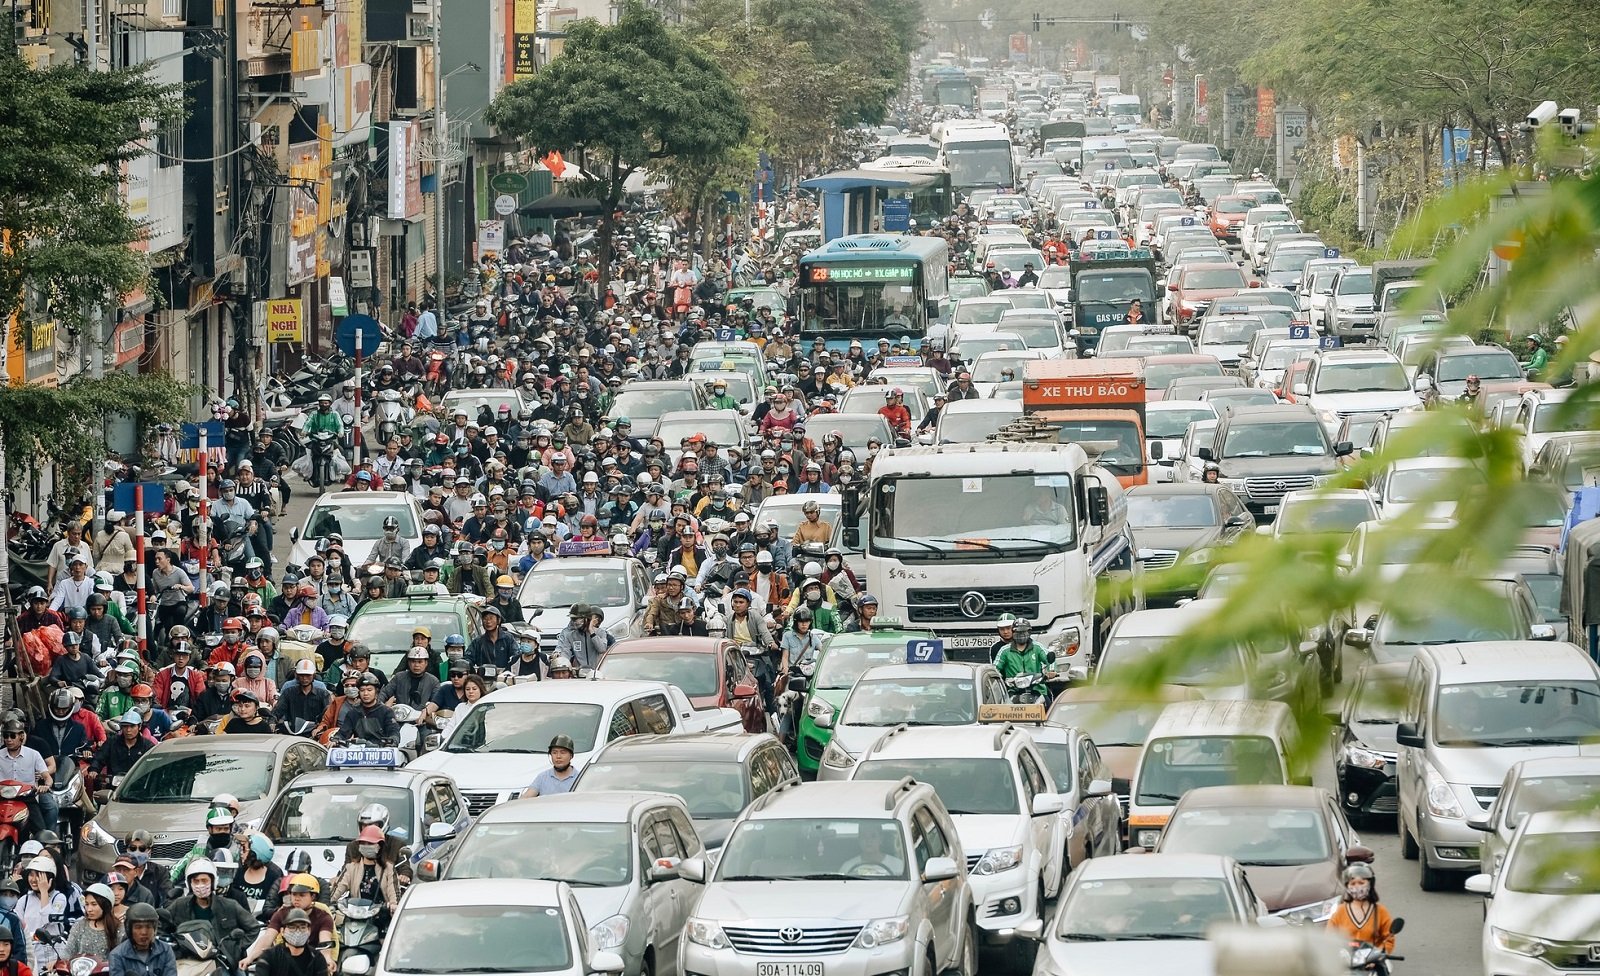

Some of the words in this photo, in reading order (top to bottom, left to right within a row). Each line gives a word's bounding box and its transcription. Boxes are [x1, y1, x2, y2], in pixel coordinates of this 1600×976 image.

[272, 302, 295, 315] NHÀ
[271, 315, 298, 331] NGHỈ
[1096, 314, 1111, 323] GAS
[721, 330, 732, 340] G7
[1294, 327, 1305, 338] G7
[1042, 386, 1061, 397] XE
[1064, 385, 1094, 397] THƯ
[1098, 384, 1128, 396] BÁO
[953, 638, 994, 647] 30V-7696
[915, 642, 934, 660] G7
[347, 751, 363, 761] SAO
[759, 964, 821, 976] 30A-114.09
